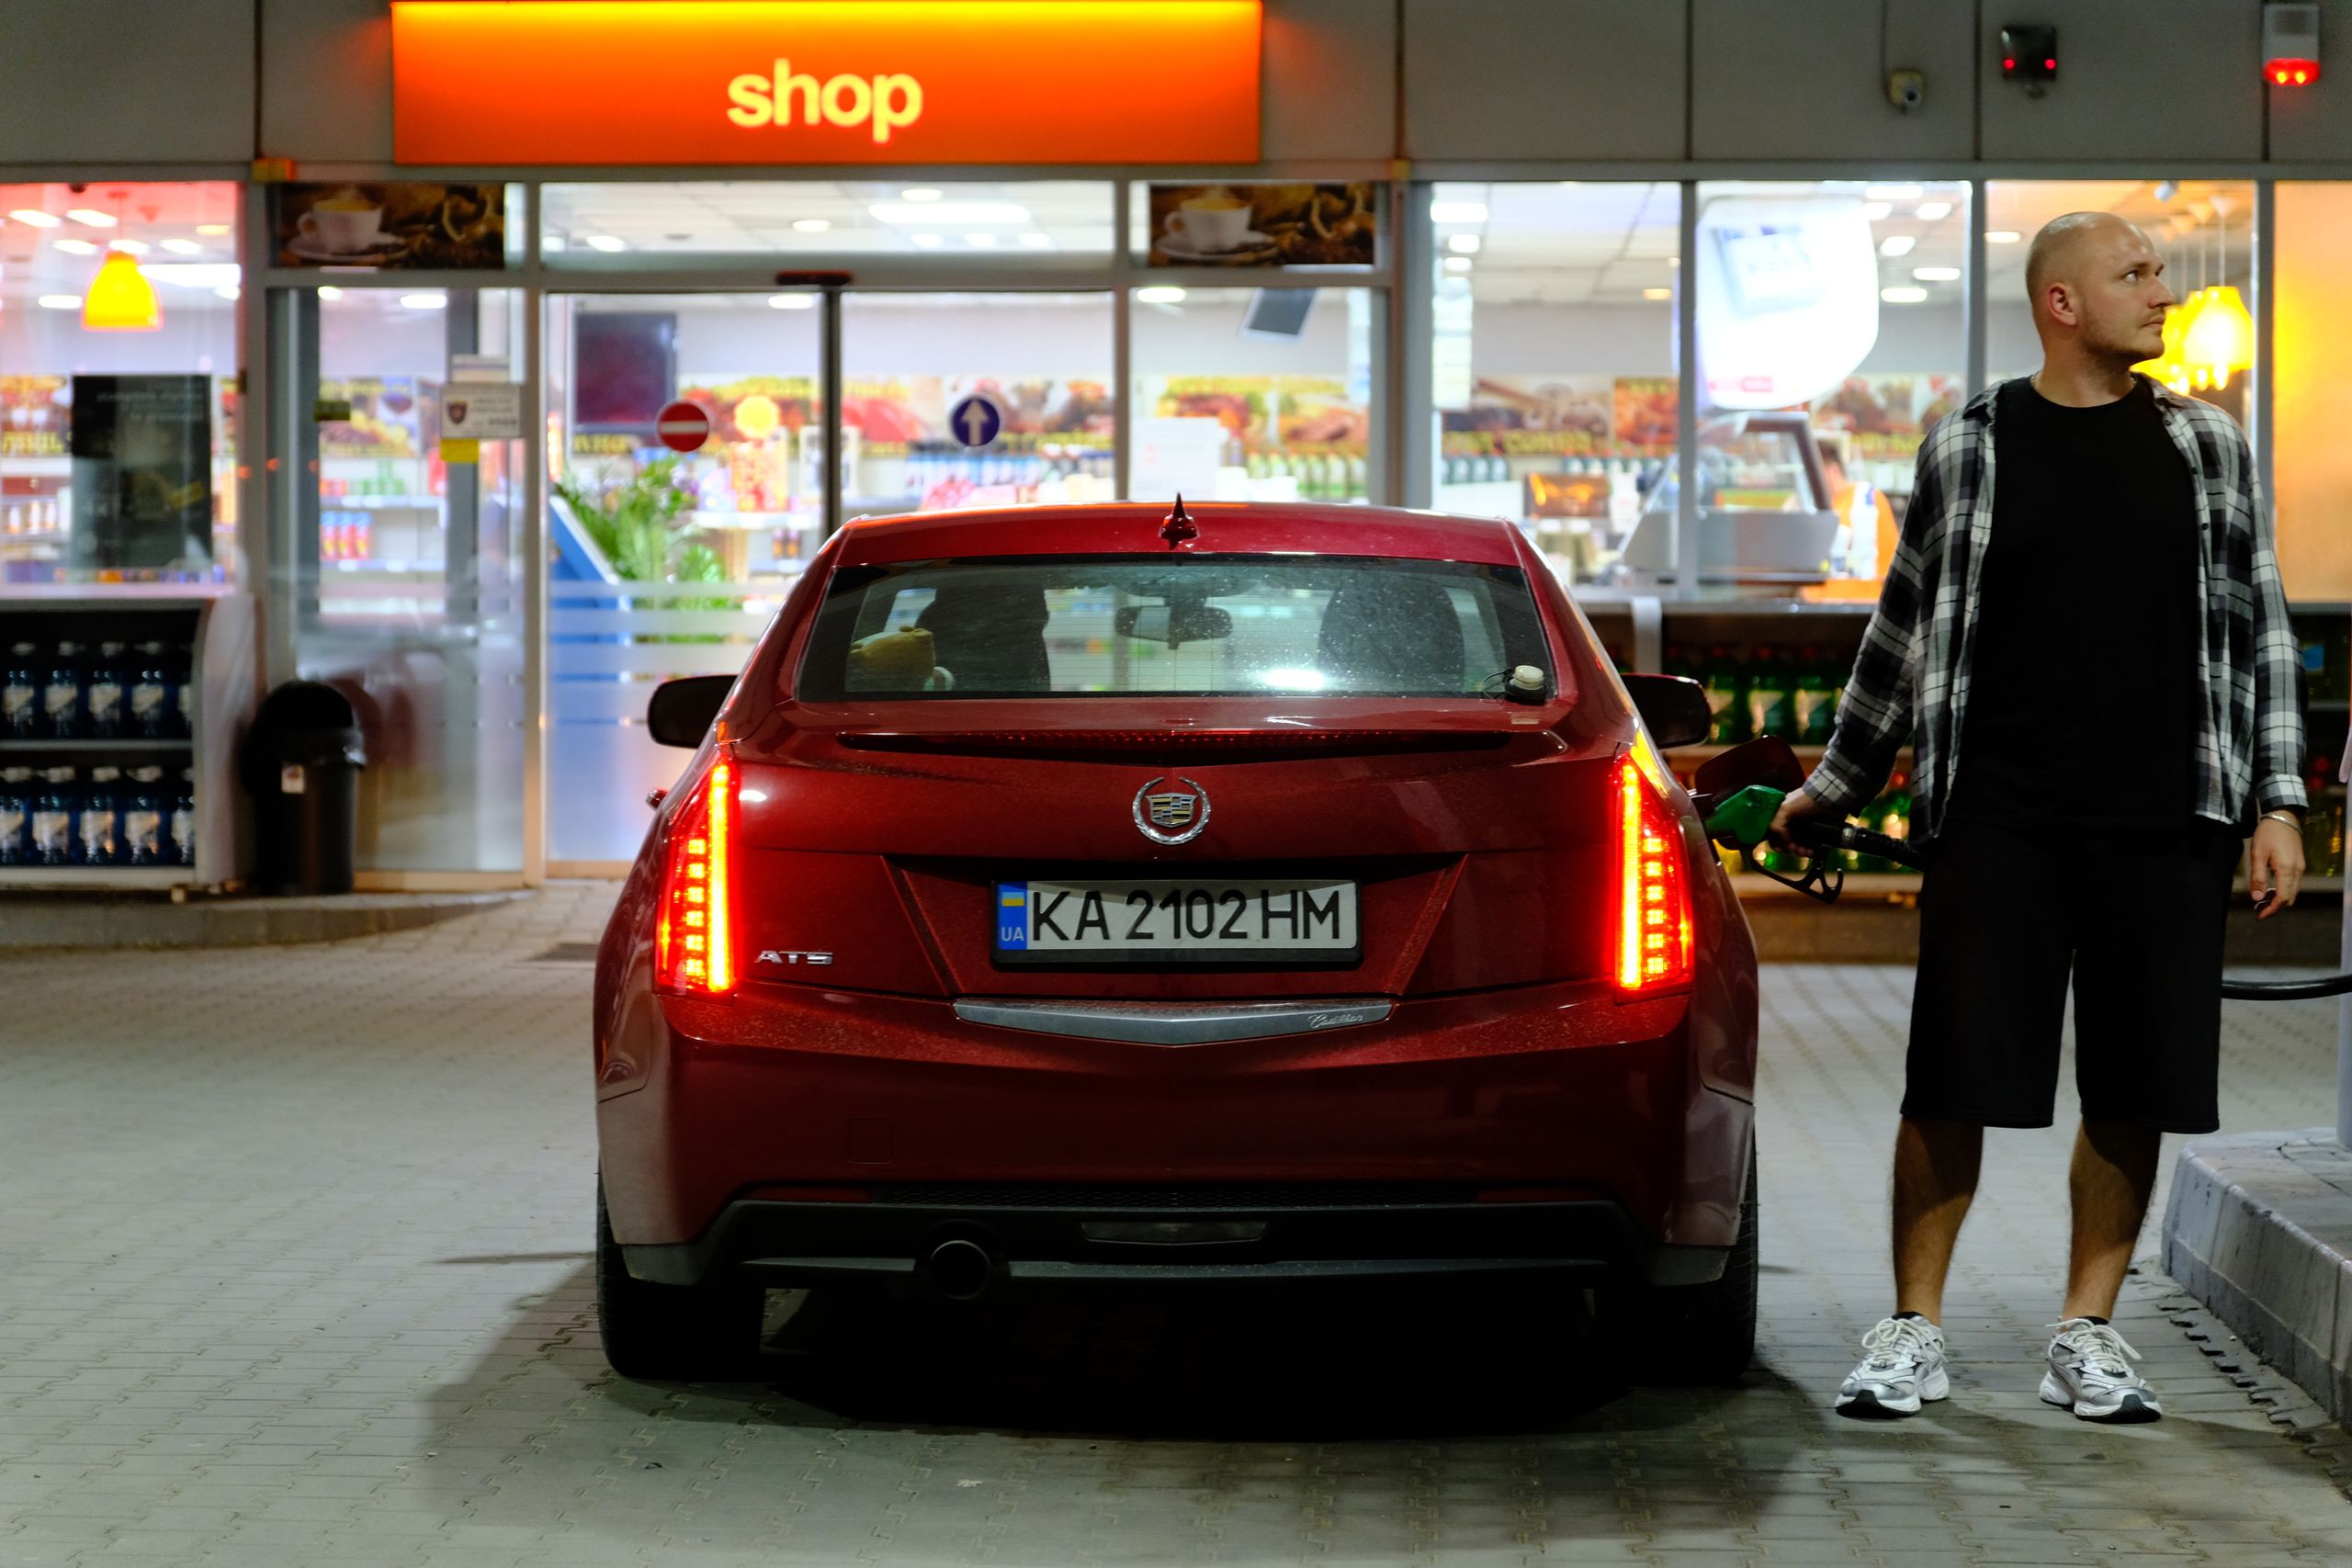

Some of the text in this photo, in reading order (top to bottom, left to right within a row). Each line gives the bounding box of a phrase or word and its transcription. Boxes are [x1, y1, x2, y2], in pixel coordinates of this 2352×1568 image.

[727, 58, 923, 144] shop
[1033, 889, 1340, 941] KA 2102 HM
[1001, 927, 1025, 942] UA
[754, 950, 833, 964] ATS
[1307, 1013, 1364, 1029] Cadillac
